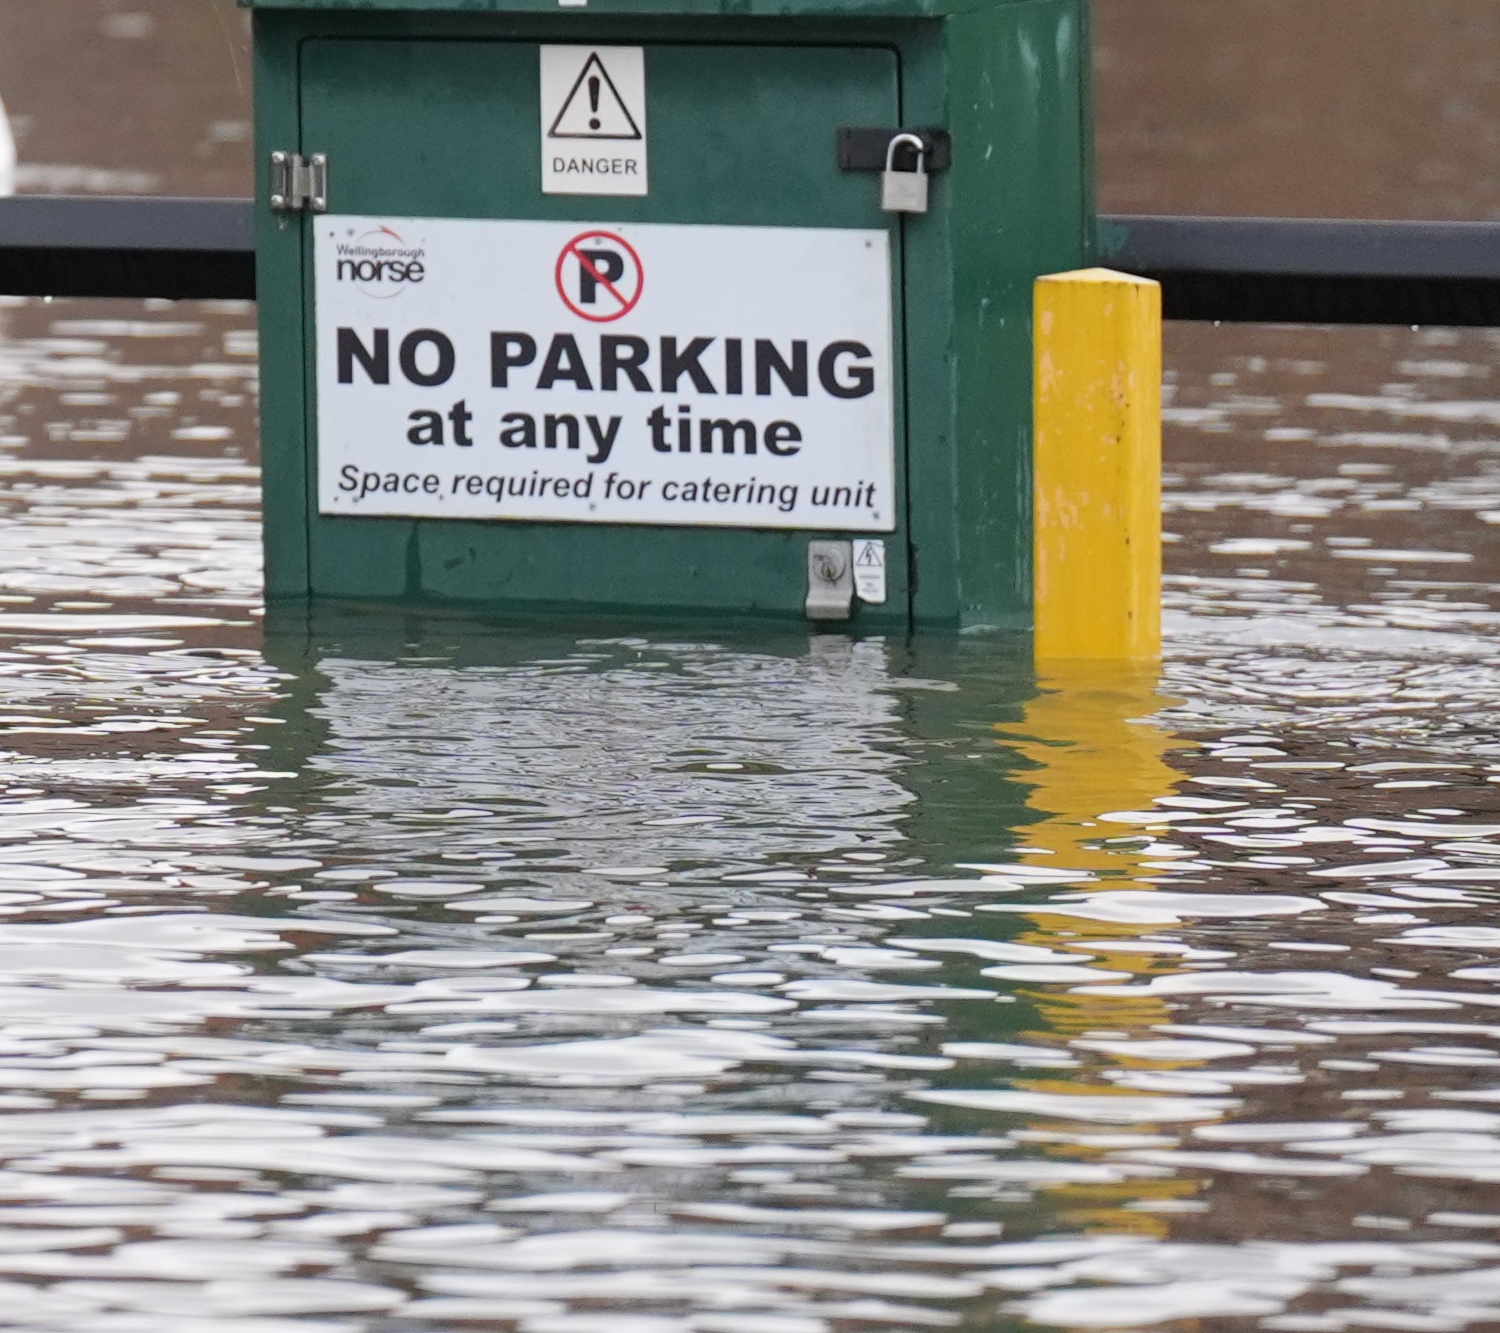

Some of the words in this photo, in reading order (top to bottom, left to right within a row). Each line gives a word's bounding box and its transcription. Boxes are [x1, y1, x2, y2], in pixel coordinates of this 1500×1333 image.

[553, 157, 638, 175] DANGER
[336, 244, 425, 259] Wellingborough
[337, 258, 425, 283] norse
[336, 328, 456, 386] NO
[490, 331, 875, 399] PARKING
[406, 399, 473, 447] at
[499, 410, 623, 464] any
[647, 404, 803, 456] time
[338, 464, 440, 500] Space
[451, 470, 594, 502] required
[604, 472, 652, 501] for
[662, 476, 799, 512] catering
[811, 480, 877, 508] unit
